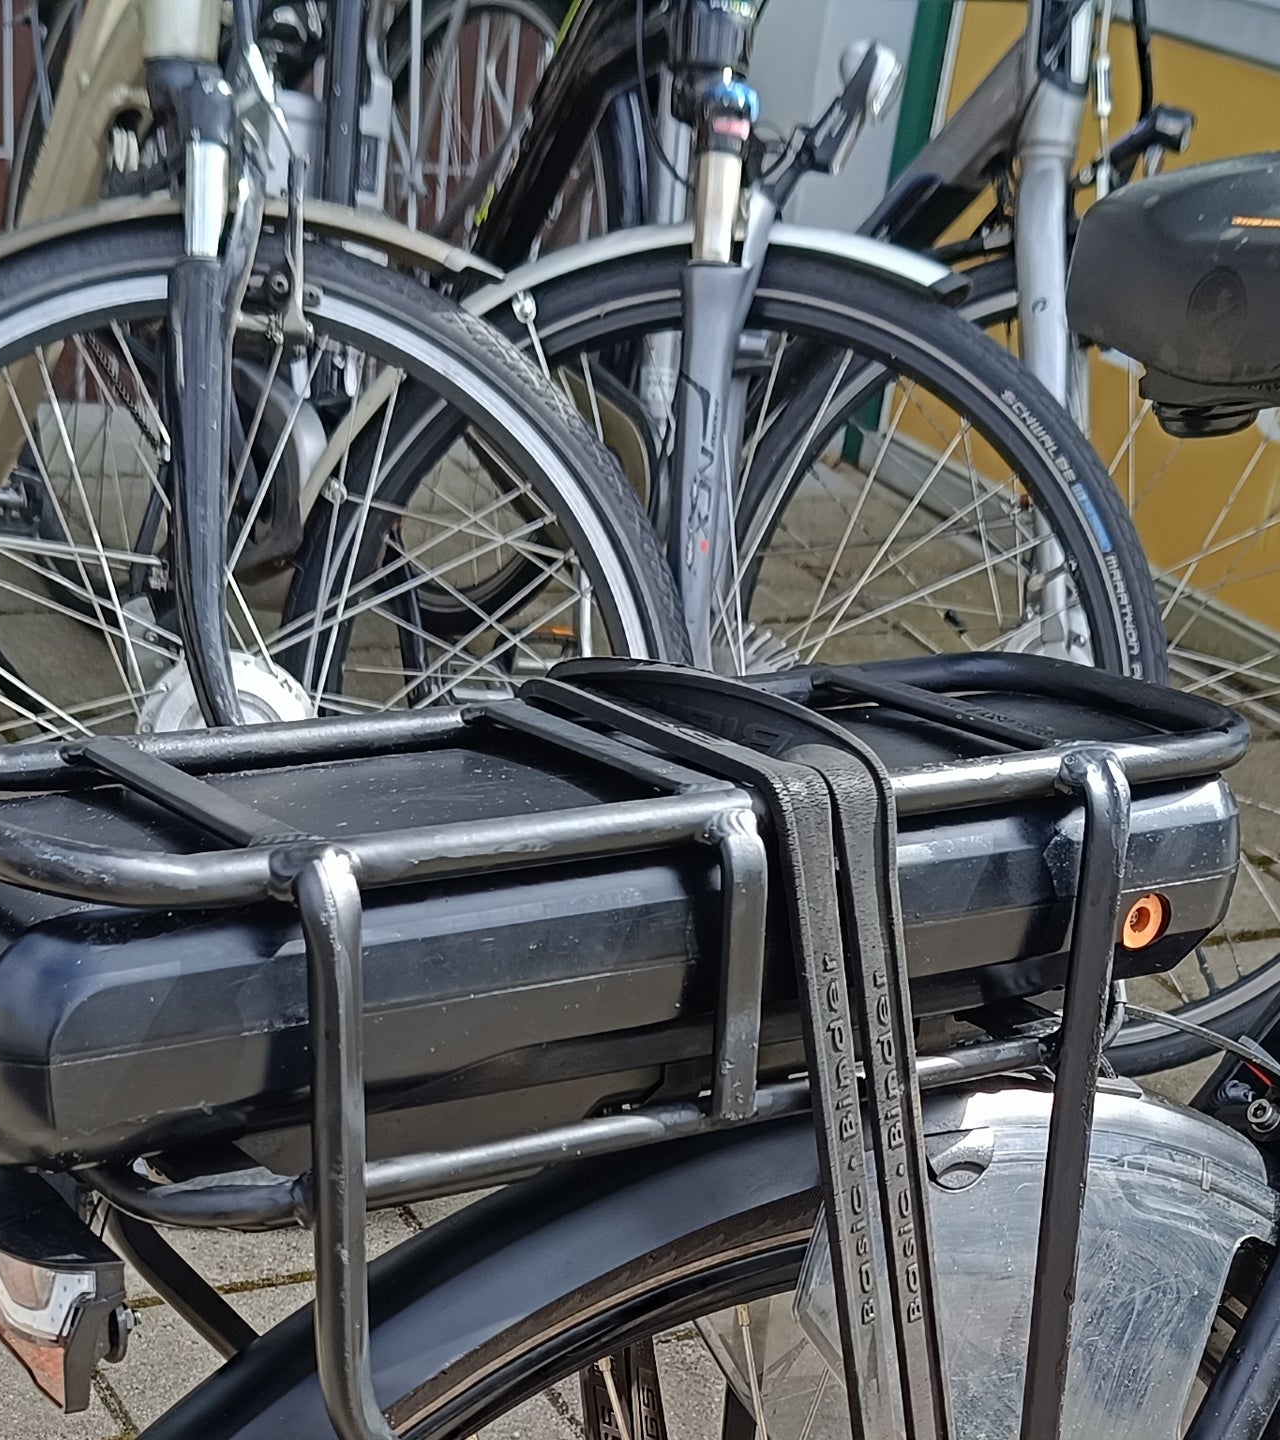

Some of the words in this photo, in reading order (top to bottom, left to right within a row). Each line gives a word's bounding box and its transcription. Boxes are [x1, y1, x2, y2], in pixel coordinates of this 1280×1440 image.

[999, 388, 1077, 484] SCHWALBE
[1105, 555, 1140, 652] MARATHON
[822, 951, 858, 1142] Binder
[873, 969, 906, 1150] Binder
[850, 1190, 877, 1326] Basic
[898, 1188, 923, 1324] Basic
